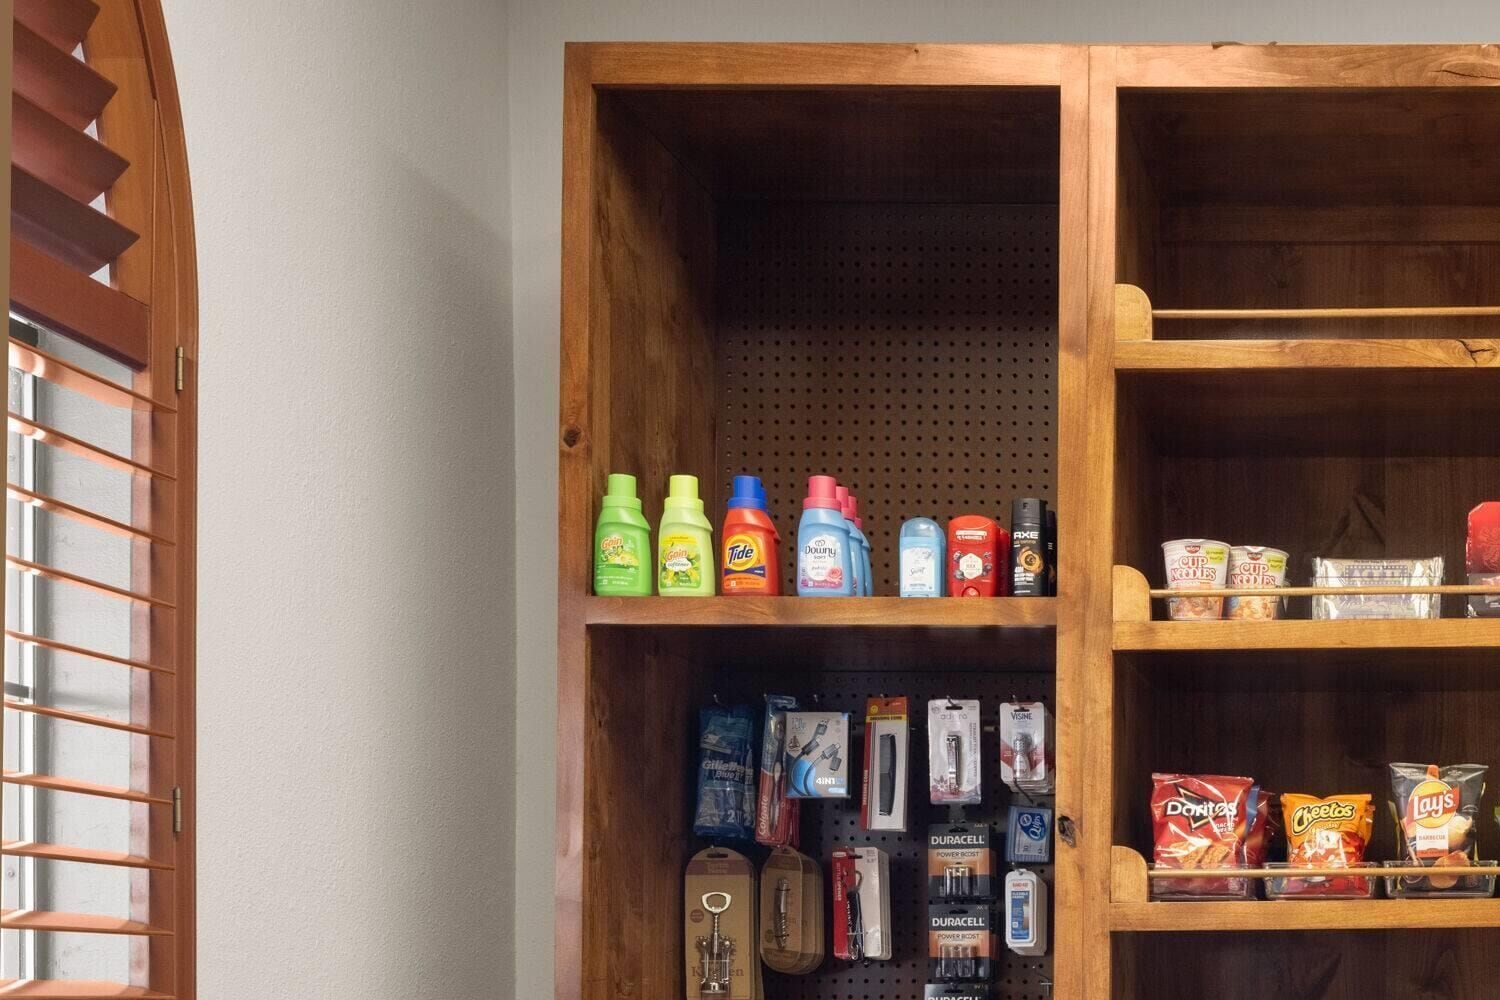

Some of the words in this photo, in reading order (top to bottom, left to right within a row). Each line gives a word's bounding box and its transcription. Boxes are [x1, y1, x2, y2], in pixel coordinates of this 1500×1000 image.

[1013, 531, 1039, 539] AXE
[601, 536, 624, 550] Gain
[666, 550, 688, 561] Gain
[728, 544, 754, 564] Tide
[805, 545, 837, 558] Downy
[1180, 555, 1208, 569] CUP
[1240, 562, 1270, 575] CUP
[1171, 567, 1217, 581] NOODLES
[1231, 574, 1276, 585] NOODLES
[1010, 712, 1033, 721] VISINE
[702, 759, 746, 773] Gillette
[1166, 801, 1237, 817] Doritos
[1413, 790, 1454, 821] Lay's
[757, 795, 769, 836] Colgate
[1292, 801, 1354, 834] Cheetos
[931, 835, 985, 845] DURACELL
[932, 917, 985, 927] DURACELL
